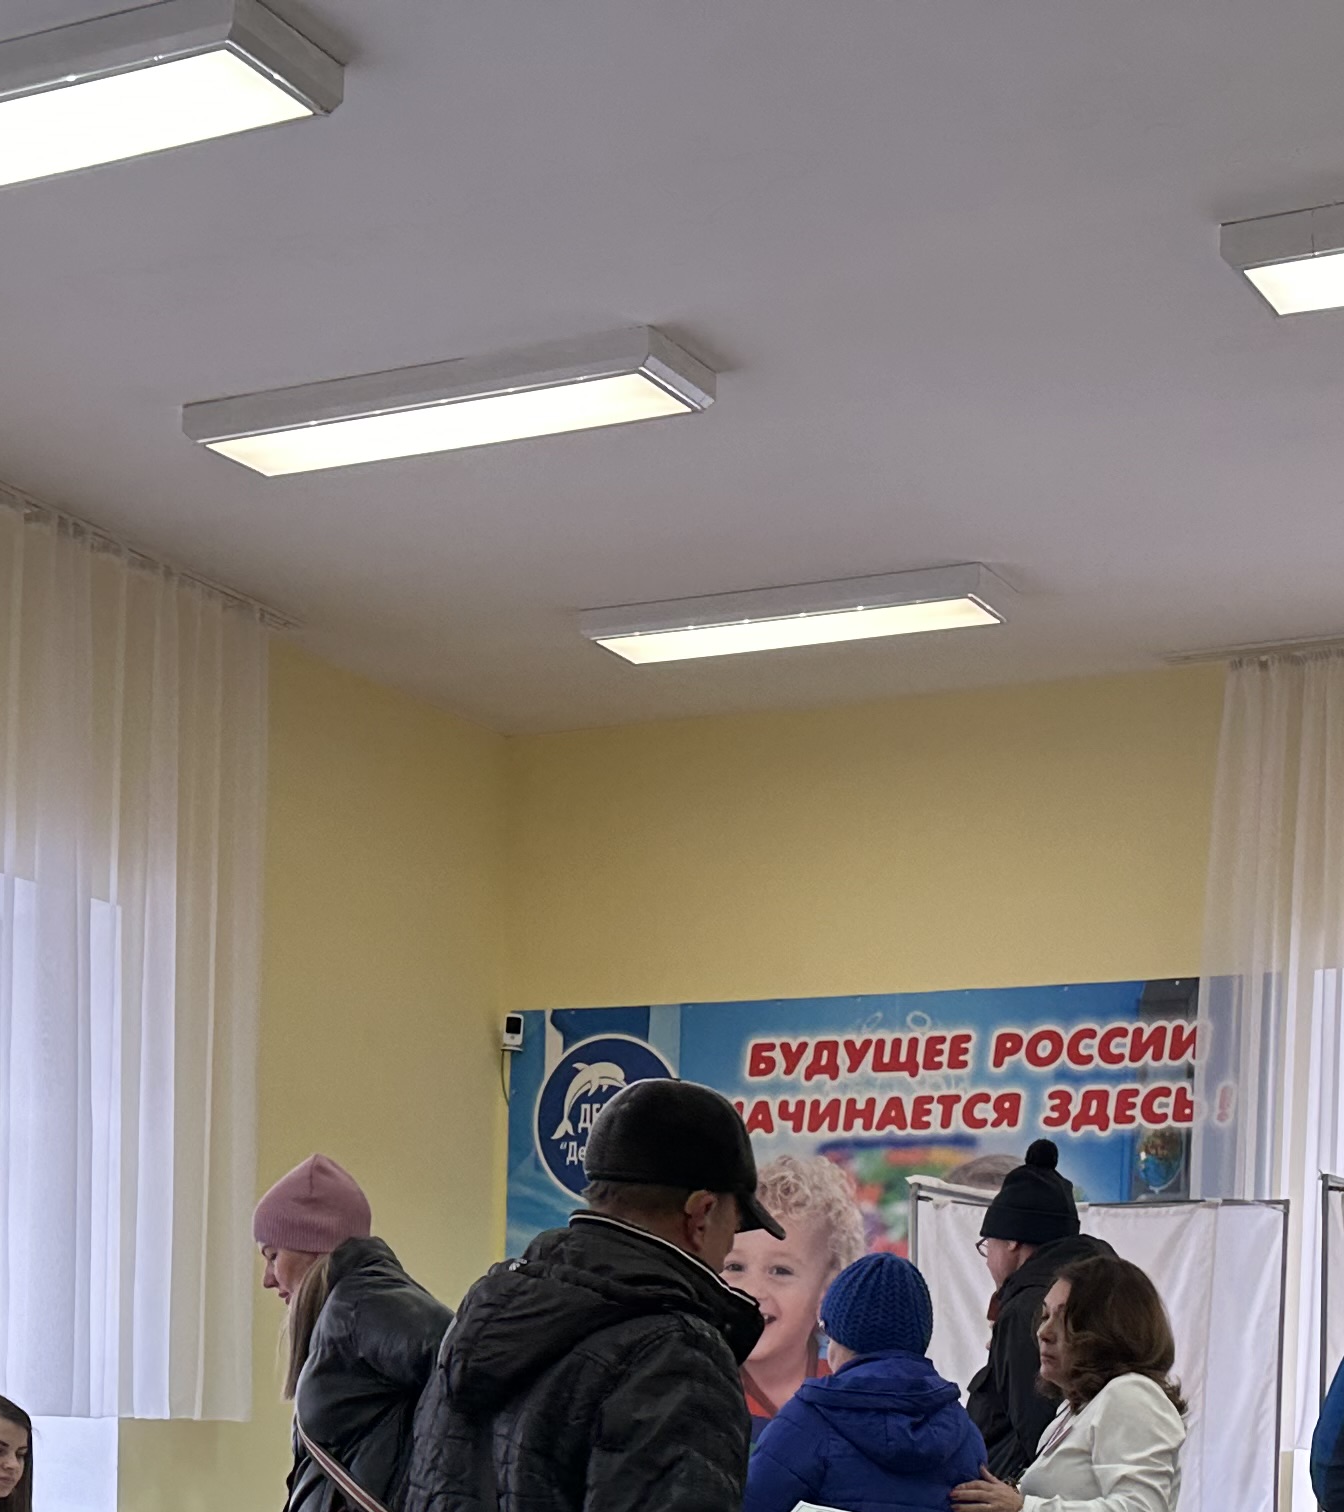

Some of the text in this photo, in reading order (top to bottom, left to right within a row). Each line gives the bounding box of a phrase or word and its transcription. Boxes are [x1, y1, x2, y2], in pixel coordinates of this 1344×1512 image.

[747, 1023, 1207, 1082] БУДУЩЕЕ РОССИИ
[733, 1092, 1022, 1134] АЧИНАЕТСЯ
